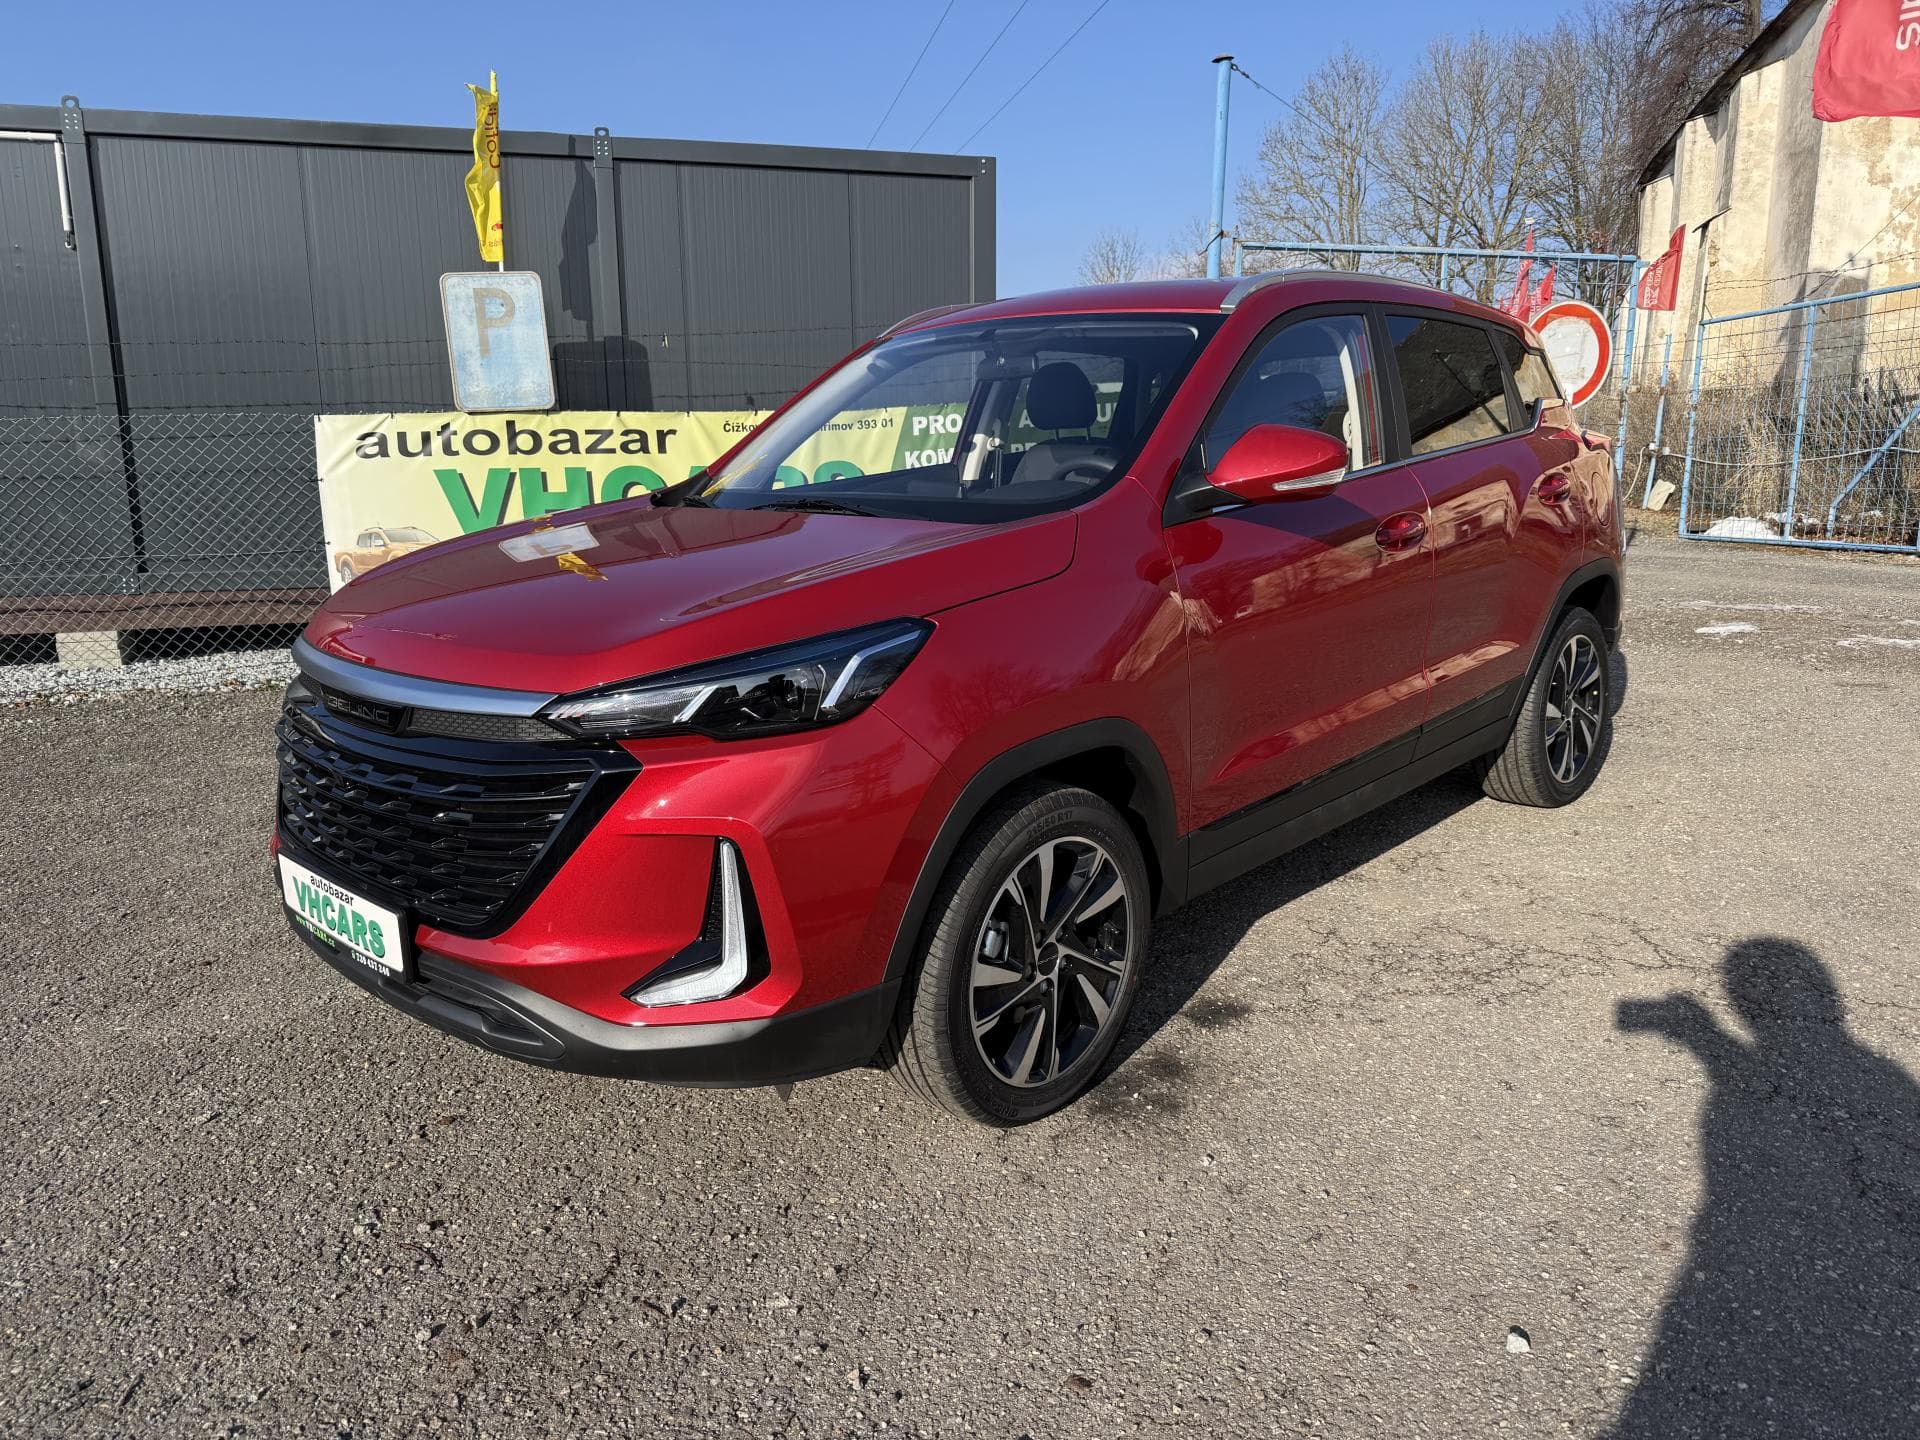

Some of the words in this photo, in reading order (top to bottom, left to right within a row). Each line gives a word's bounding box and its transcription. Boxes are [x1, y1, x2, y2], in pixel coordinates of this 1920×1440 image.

[473, 287, 515, 358] P
[355, 419, 677, 459] autobazar
[857, 419, 877, 431] 393
[881, 416, 894, 428] 01
[310, 875, 354, 906] autobazar
[292, 875, 386, 959] VHCARS
